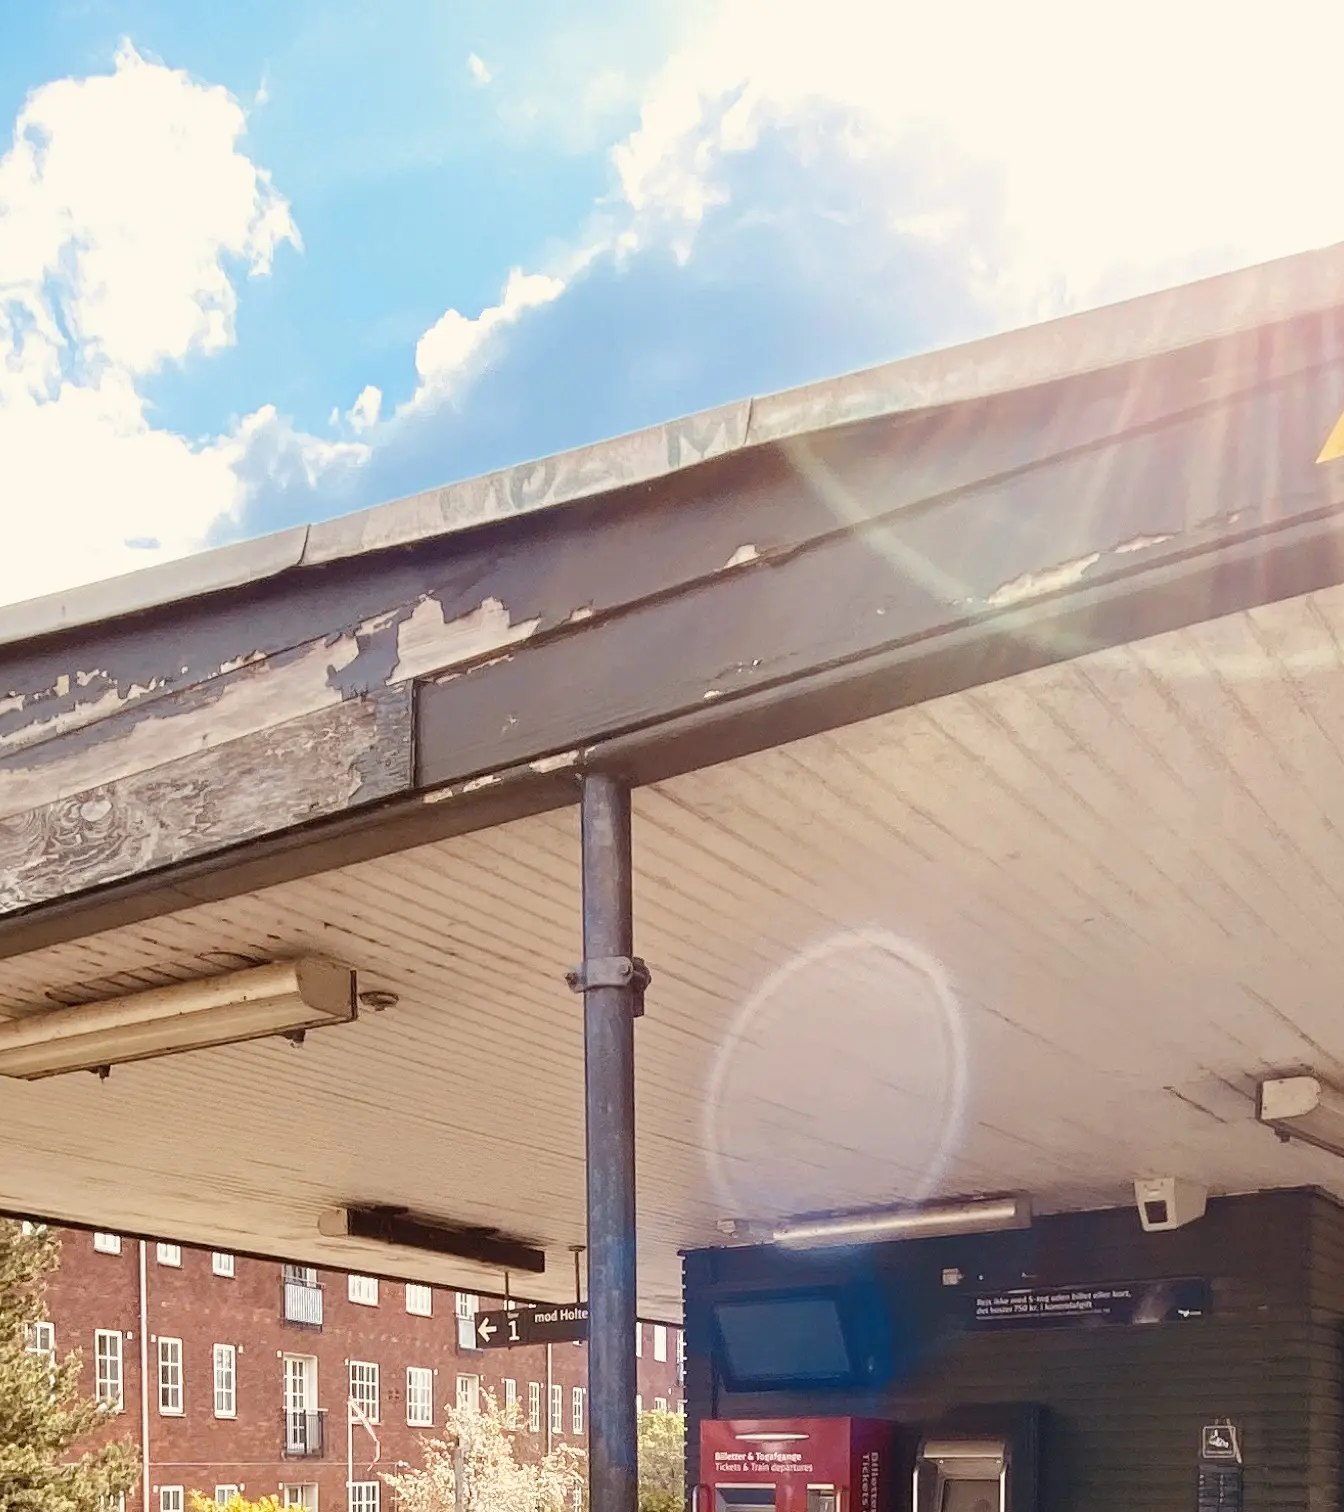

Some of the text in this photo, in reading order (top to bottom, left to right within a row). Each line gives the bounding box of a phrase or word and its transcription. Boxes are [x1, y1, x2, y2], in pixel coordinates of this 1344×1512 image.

[535, 1308, 589, 1323] mod Holte
[508, 1320, 520, 1341] 1
[715, 1451, 746, 1461] Billetter
[747, 1452, 754, 1461] &
[715, 1462, 814, 1473] Tickets & Train departures
[862, 1453, 870, 1506] Tickets
